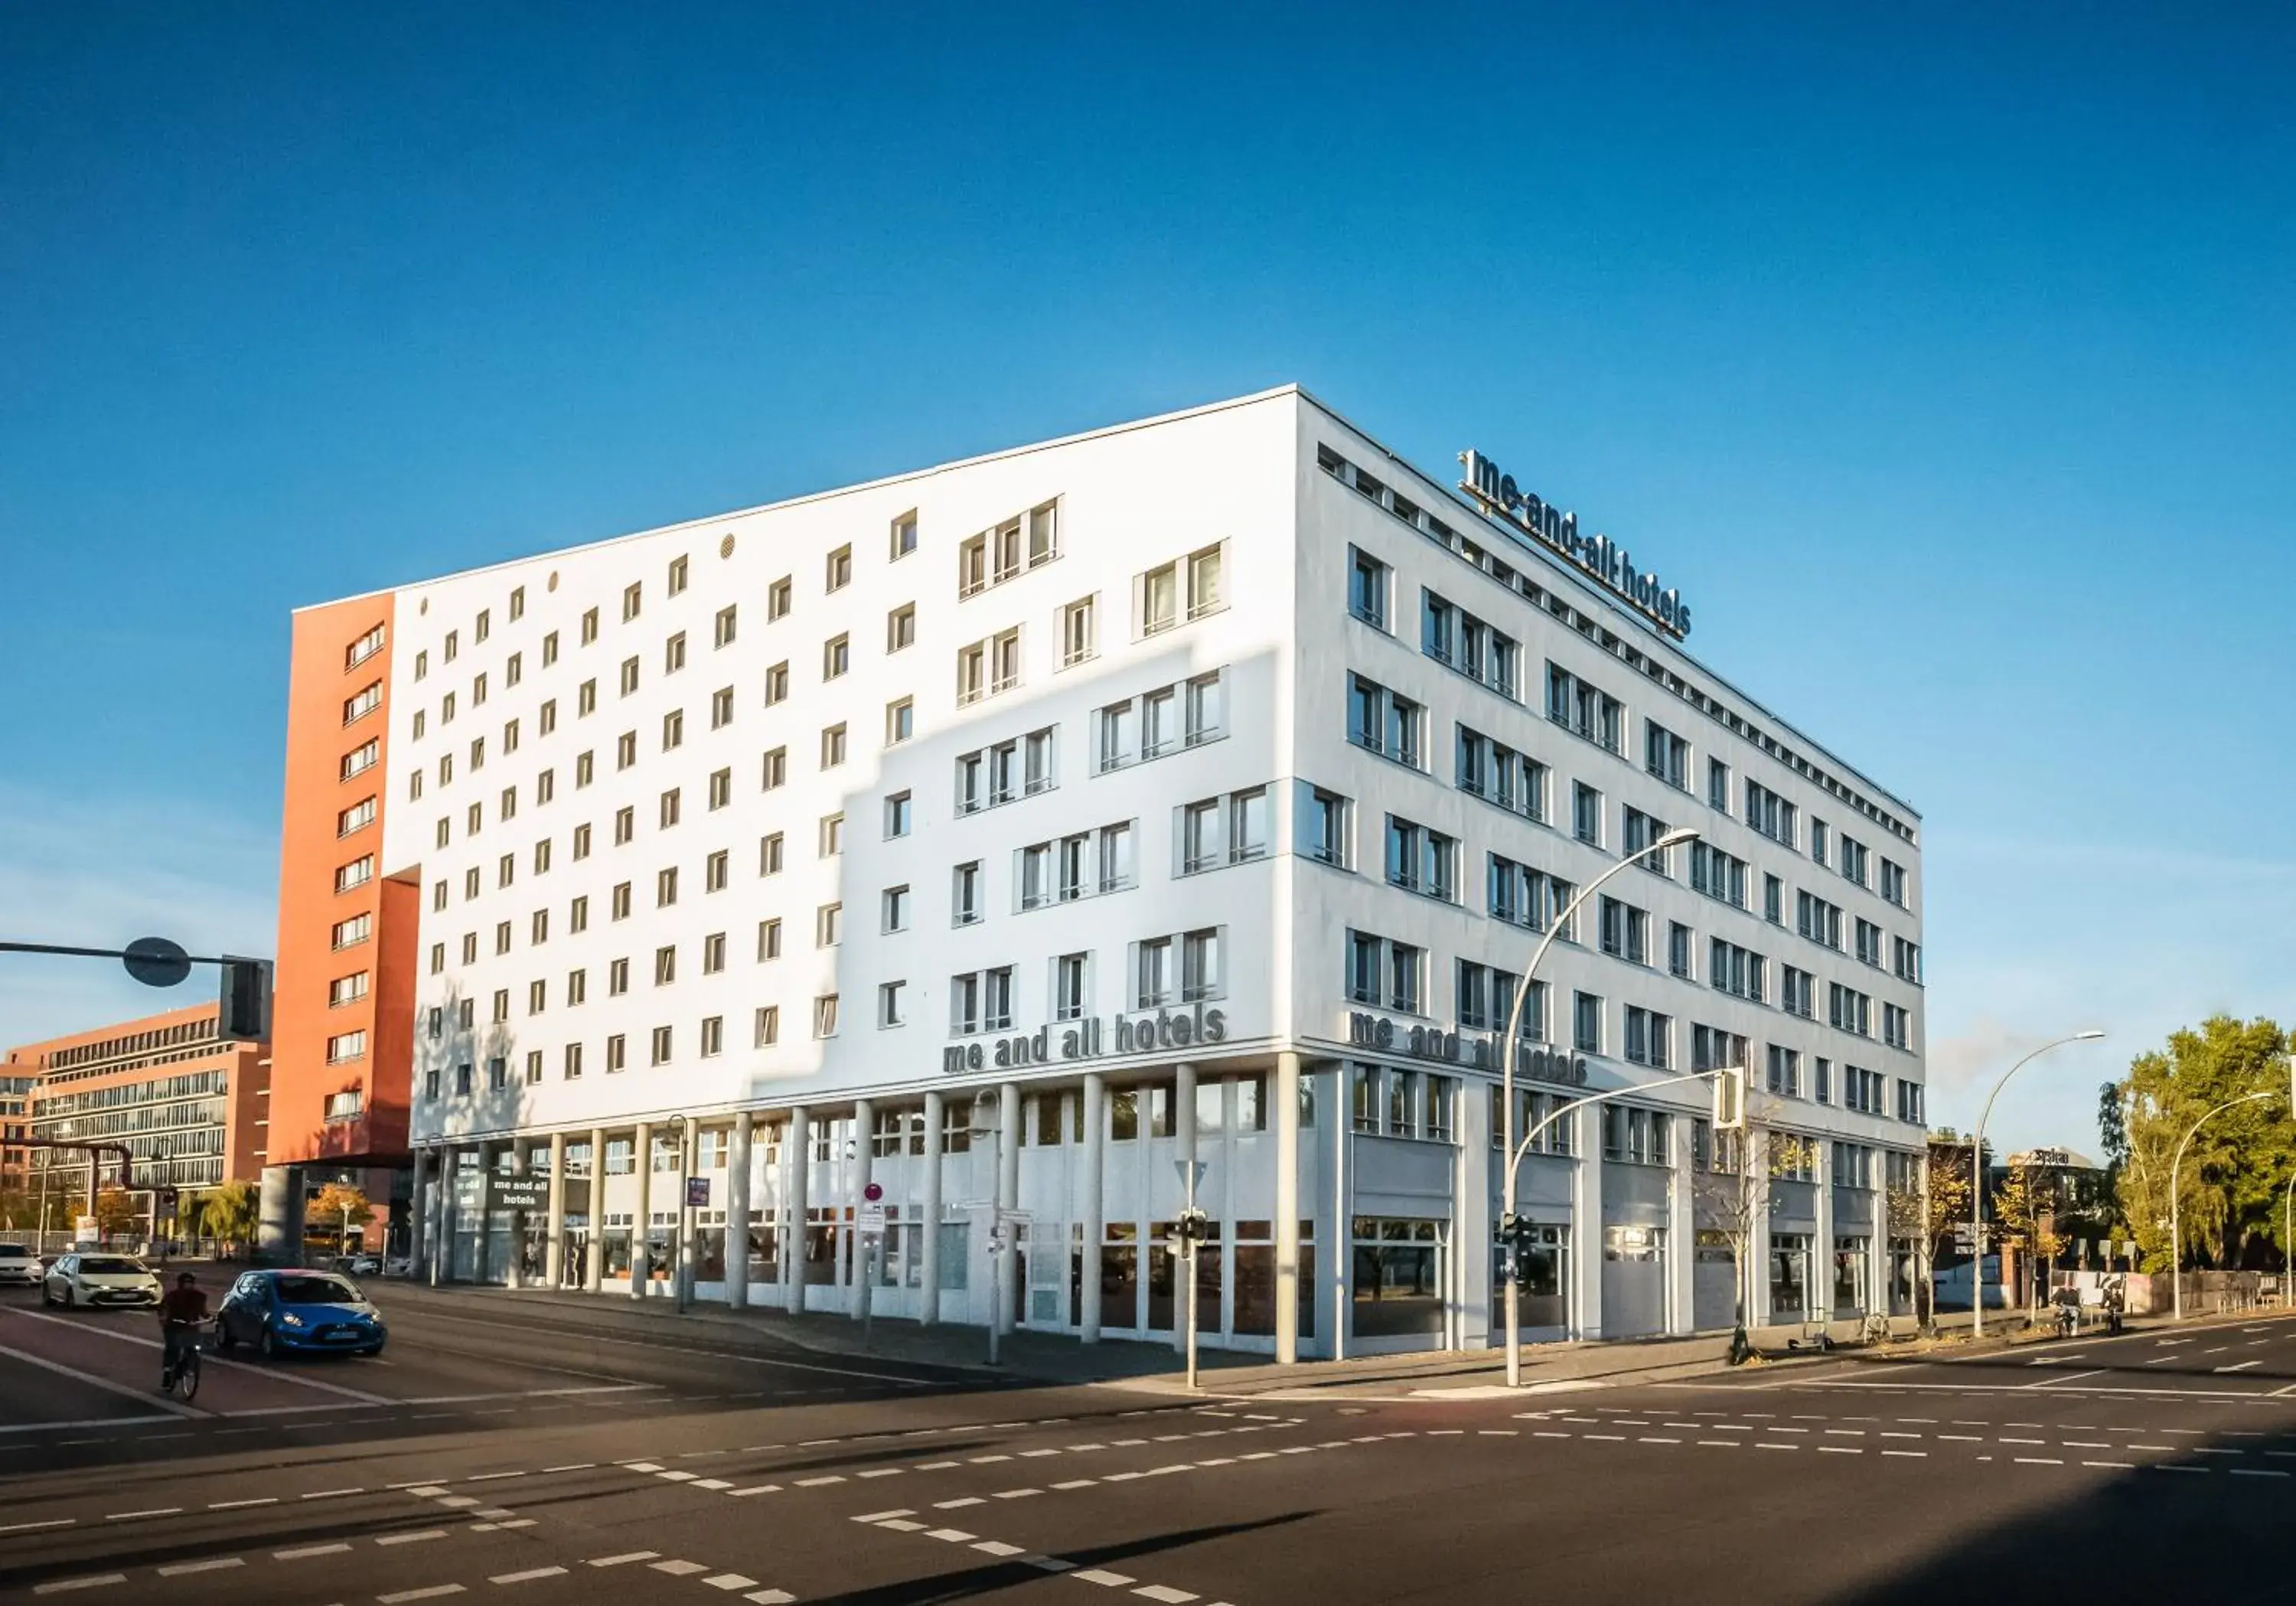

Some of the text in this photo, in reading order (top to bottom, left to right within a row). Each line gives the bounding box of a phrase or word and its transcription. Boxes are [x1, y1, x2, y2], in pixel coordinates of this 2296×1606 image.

[1465, 449, 1691, 635] me and all hotels
[943, 1002, 1226, 1072] me and all hotels
[1349, 1010, 1393, 1048] me
[1409, 1023, 1459, 1061] and
[1516, 1036, 1588, 1085] hotels
[494, 1180, 547, 1192] me and all
[503, 1193, 536, 1205] hotels
